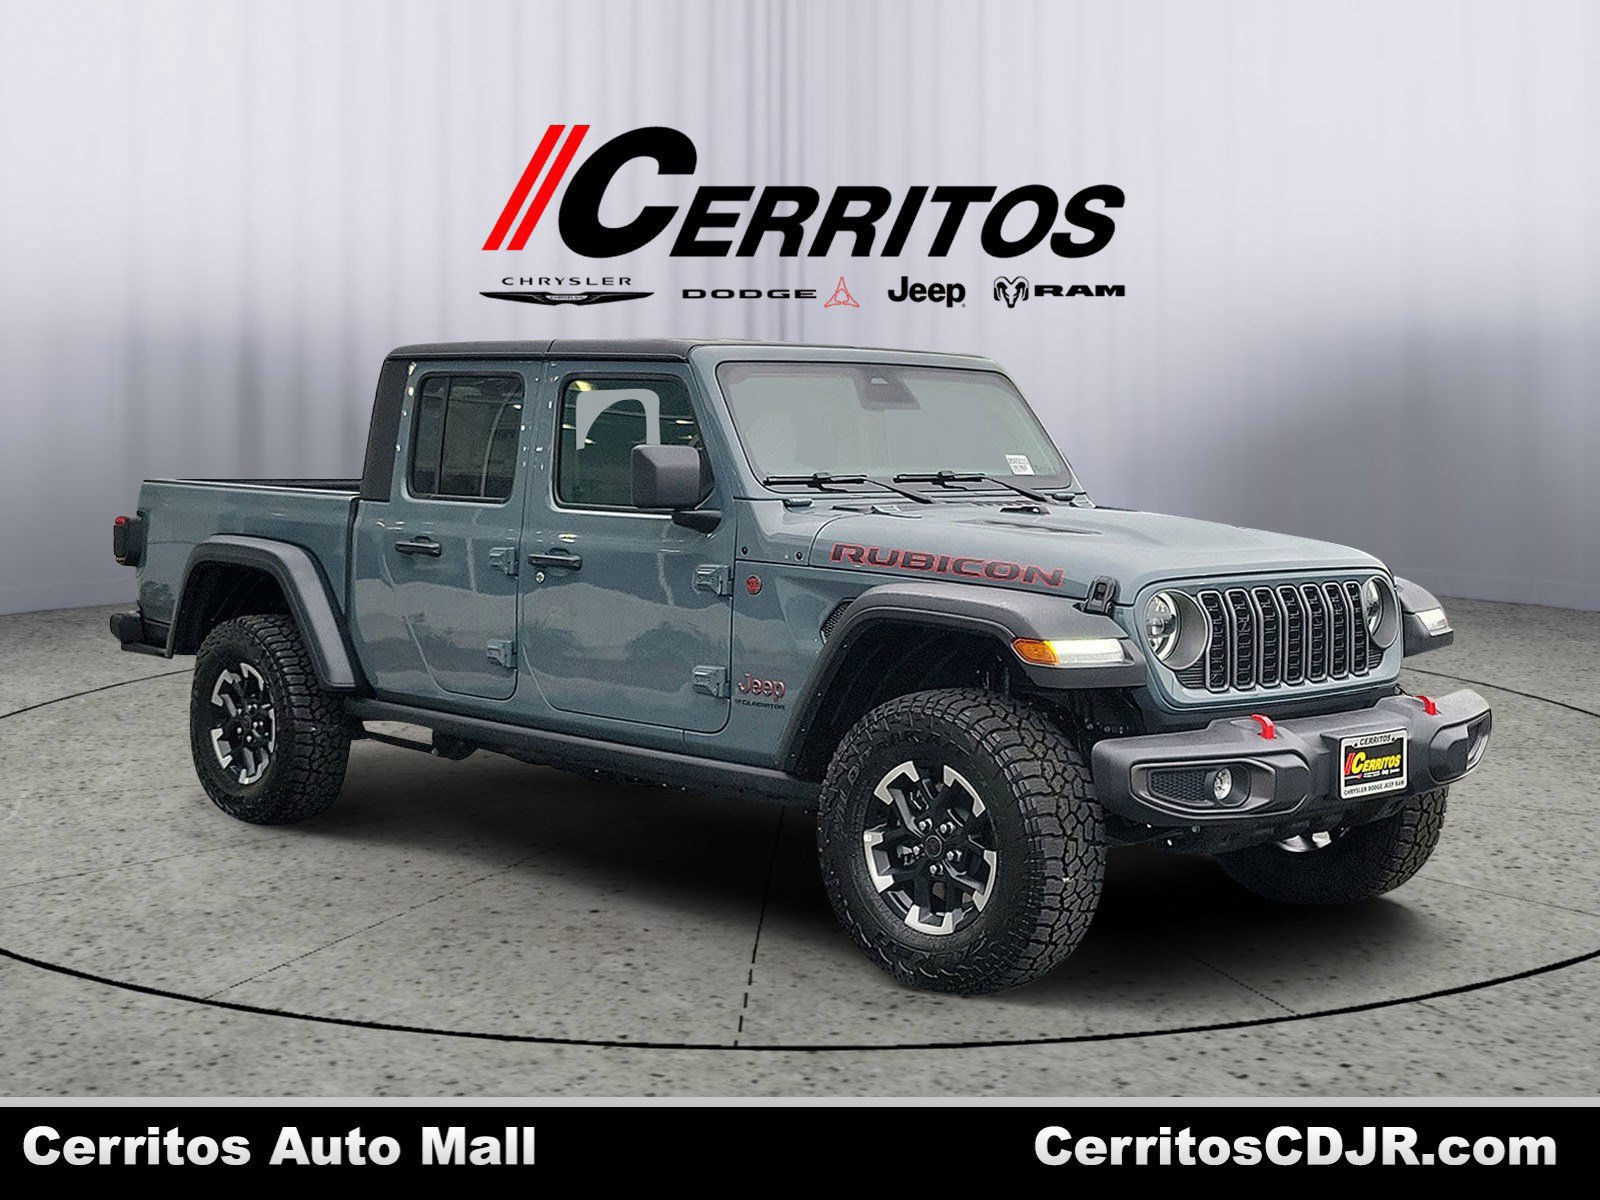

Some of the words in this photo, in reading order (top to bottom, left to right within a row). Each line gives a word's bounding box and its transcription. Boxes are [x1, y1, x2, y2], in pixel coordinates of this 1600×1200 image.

[830, 542, 1064, 588] RUBICON
[737, 672, 786, 701] Jeep
[742, 699, 786, 710] GLADIATOR
[1360, 734, 1391, 745] CERRITOS
[1351, 752, 1401, 774] CERRITOS
[1344, 787, 1367, 795] CHRYSLER
